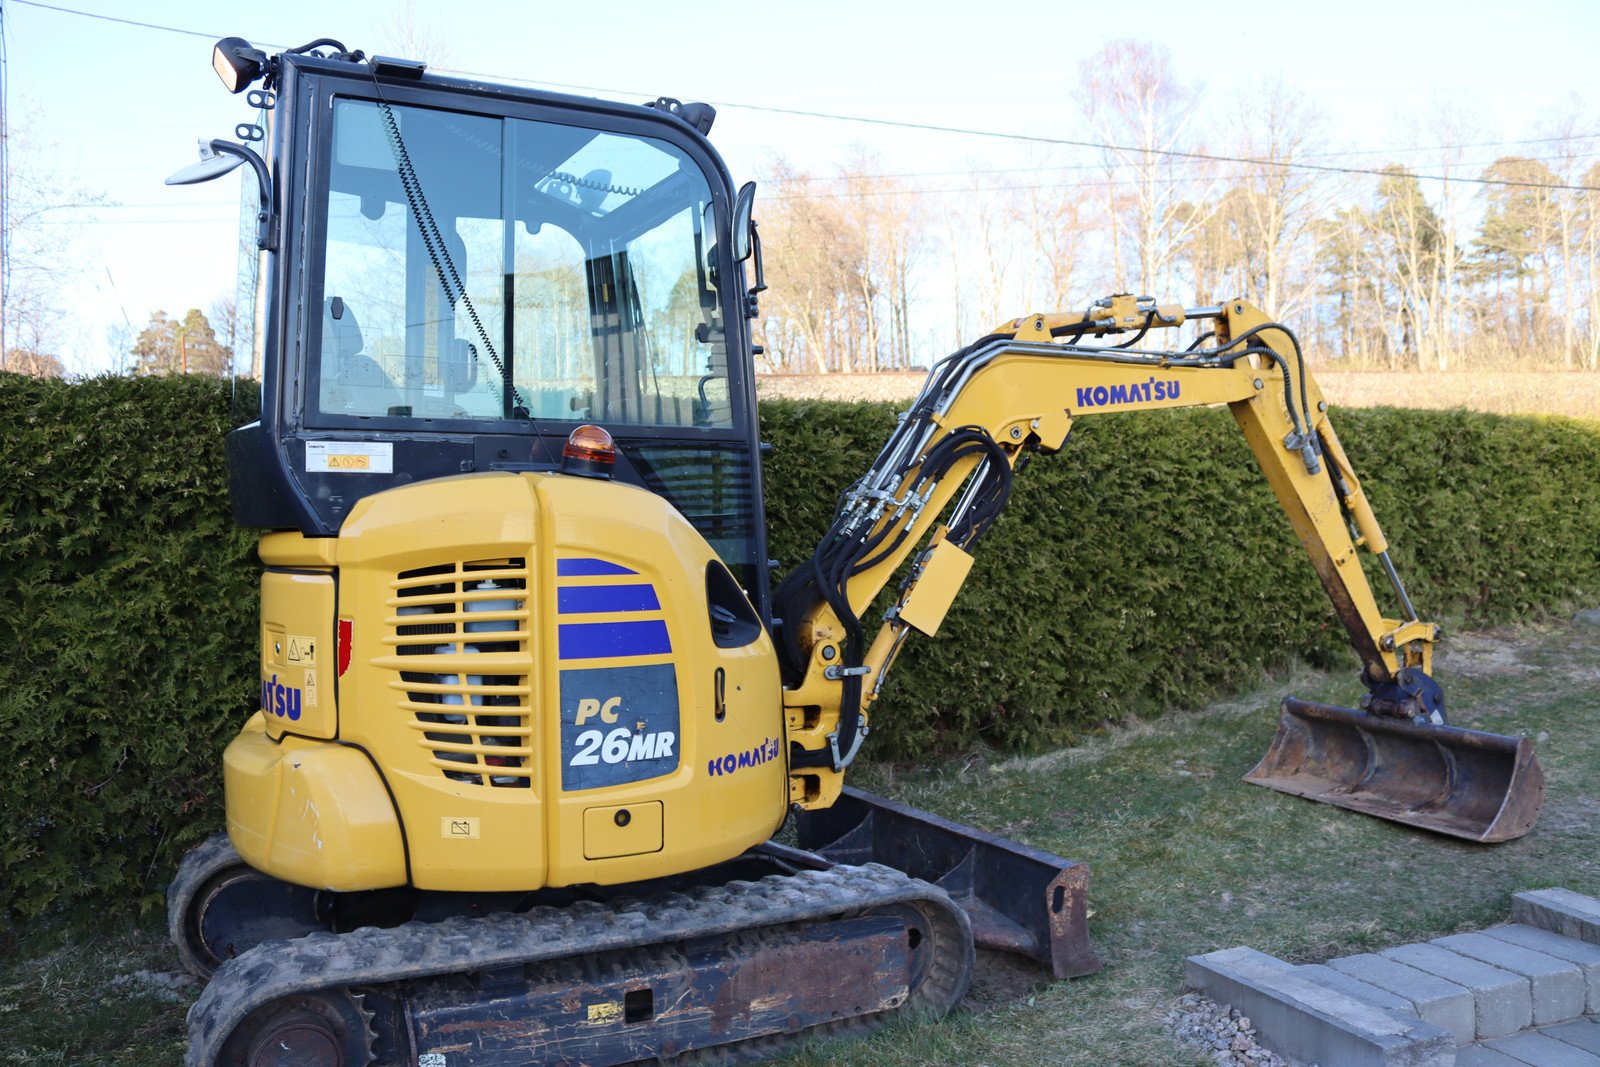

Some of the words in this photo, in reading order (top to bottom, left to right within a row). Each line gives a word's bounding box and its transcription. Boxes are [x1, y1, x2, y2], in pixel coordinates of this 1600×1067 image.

[1076, 377, 1180, 407] KOMATSU
[260, 674, 301, 721] ATSU
[574, 696, 622, 726] PC
[569, 727, 675, 767] 26MR
[708, 737, 779, 777] KOMATSU
